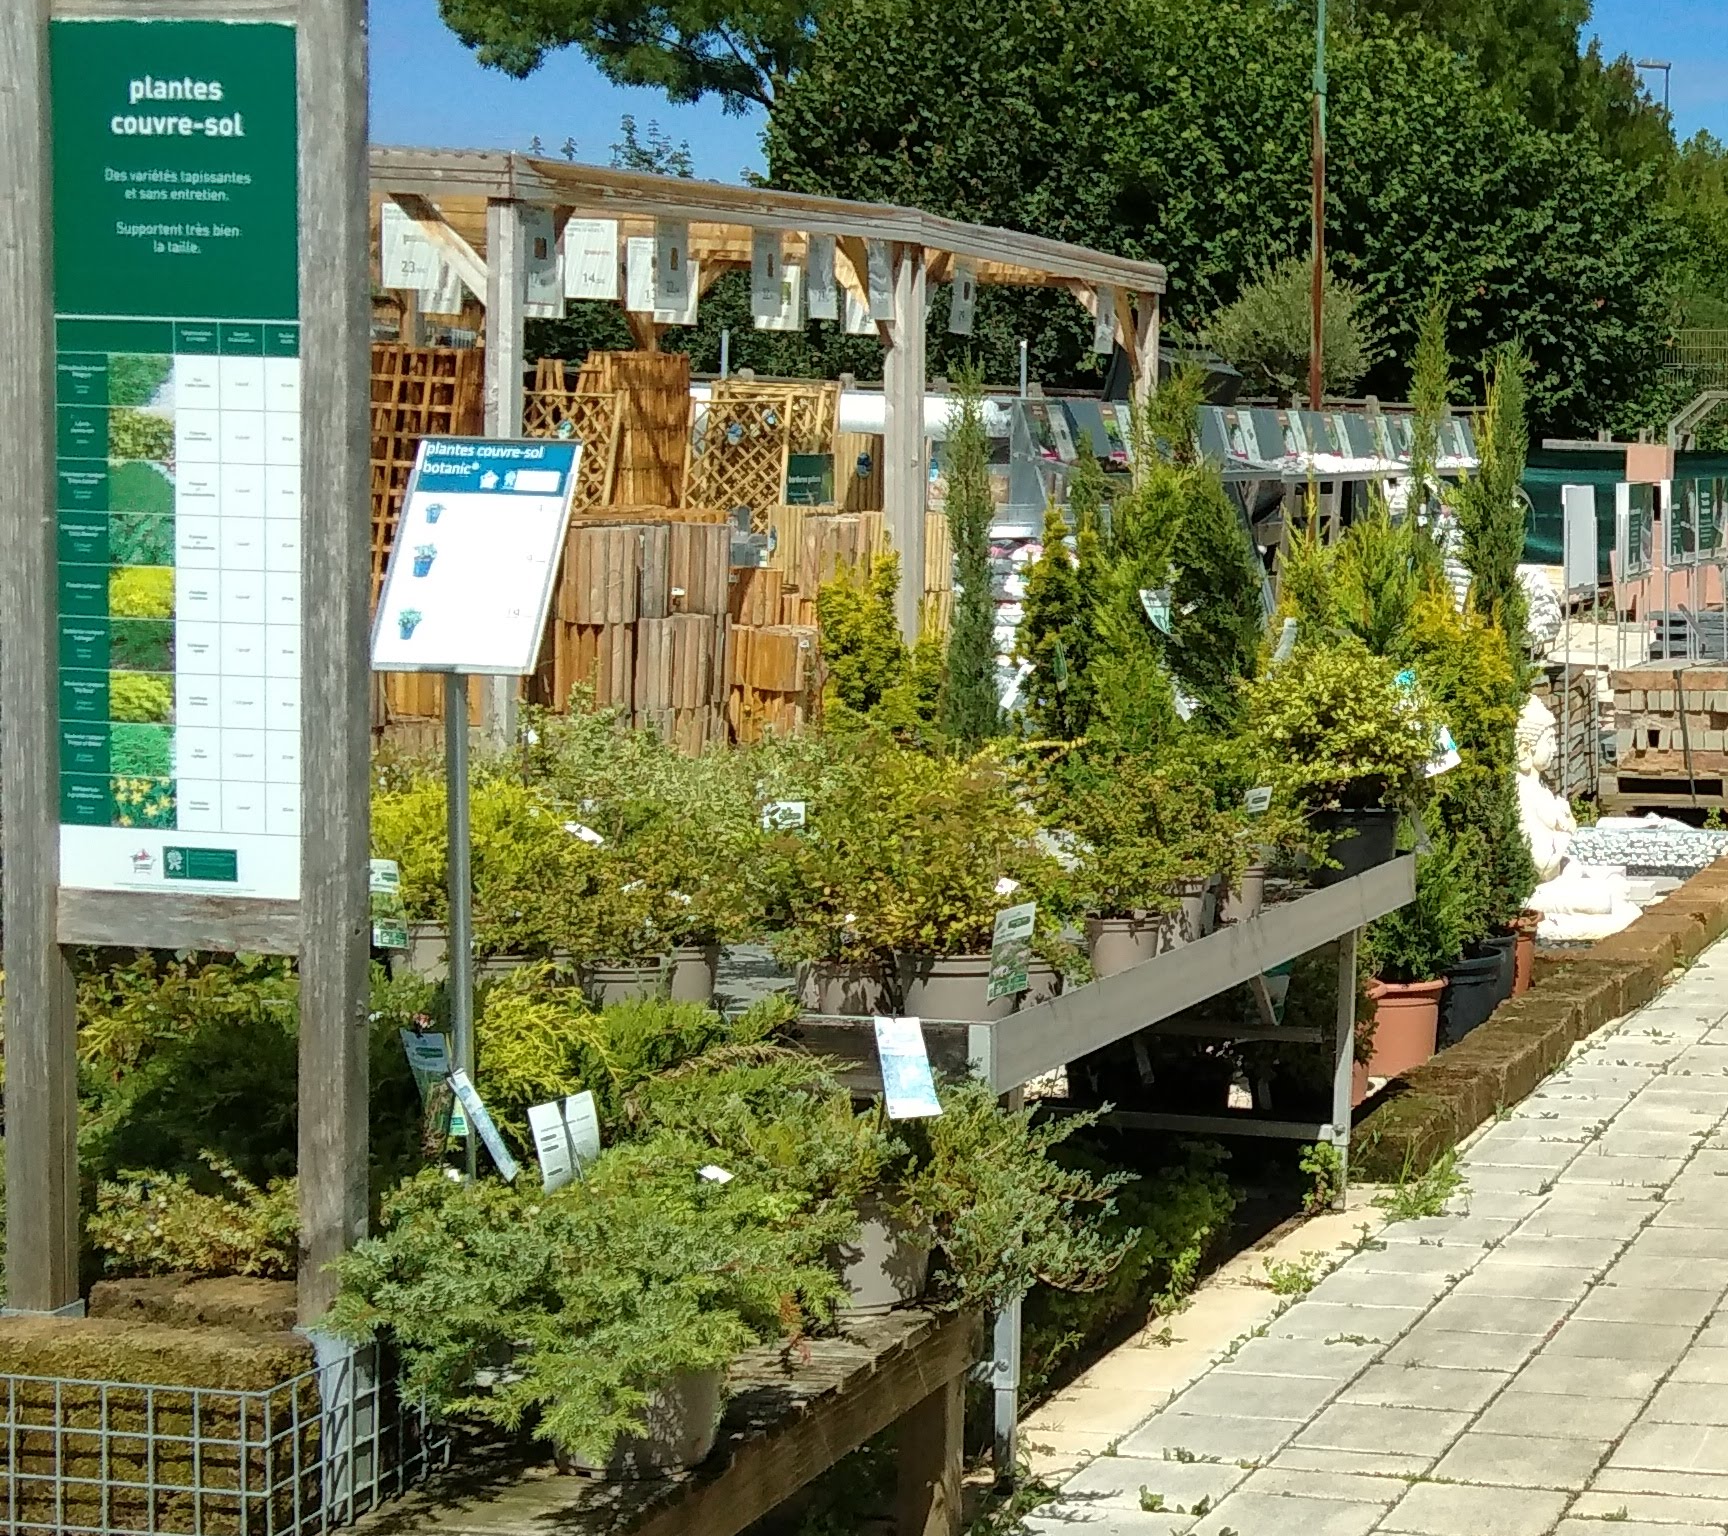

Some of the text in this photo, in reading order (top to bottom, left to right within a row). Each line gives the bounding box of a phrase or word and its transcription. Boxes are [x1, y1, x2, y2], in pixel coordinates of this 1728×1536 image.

[129, 74, 223, 105] plantes
[111, 111, 245, 137] couvre-sol
[104, 167, 252, 186] Des variétés tapissantes
[125, 188, 230, 202] et sans entretien.
[115, 220, 241, 238] Supportent très bien
[154, 240, 202, 254] la taille.
[425, 442, 545, 459] plantes couvre-sol
